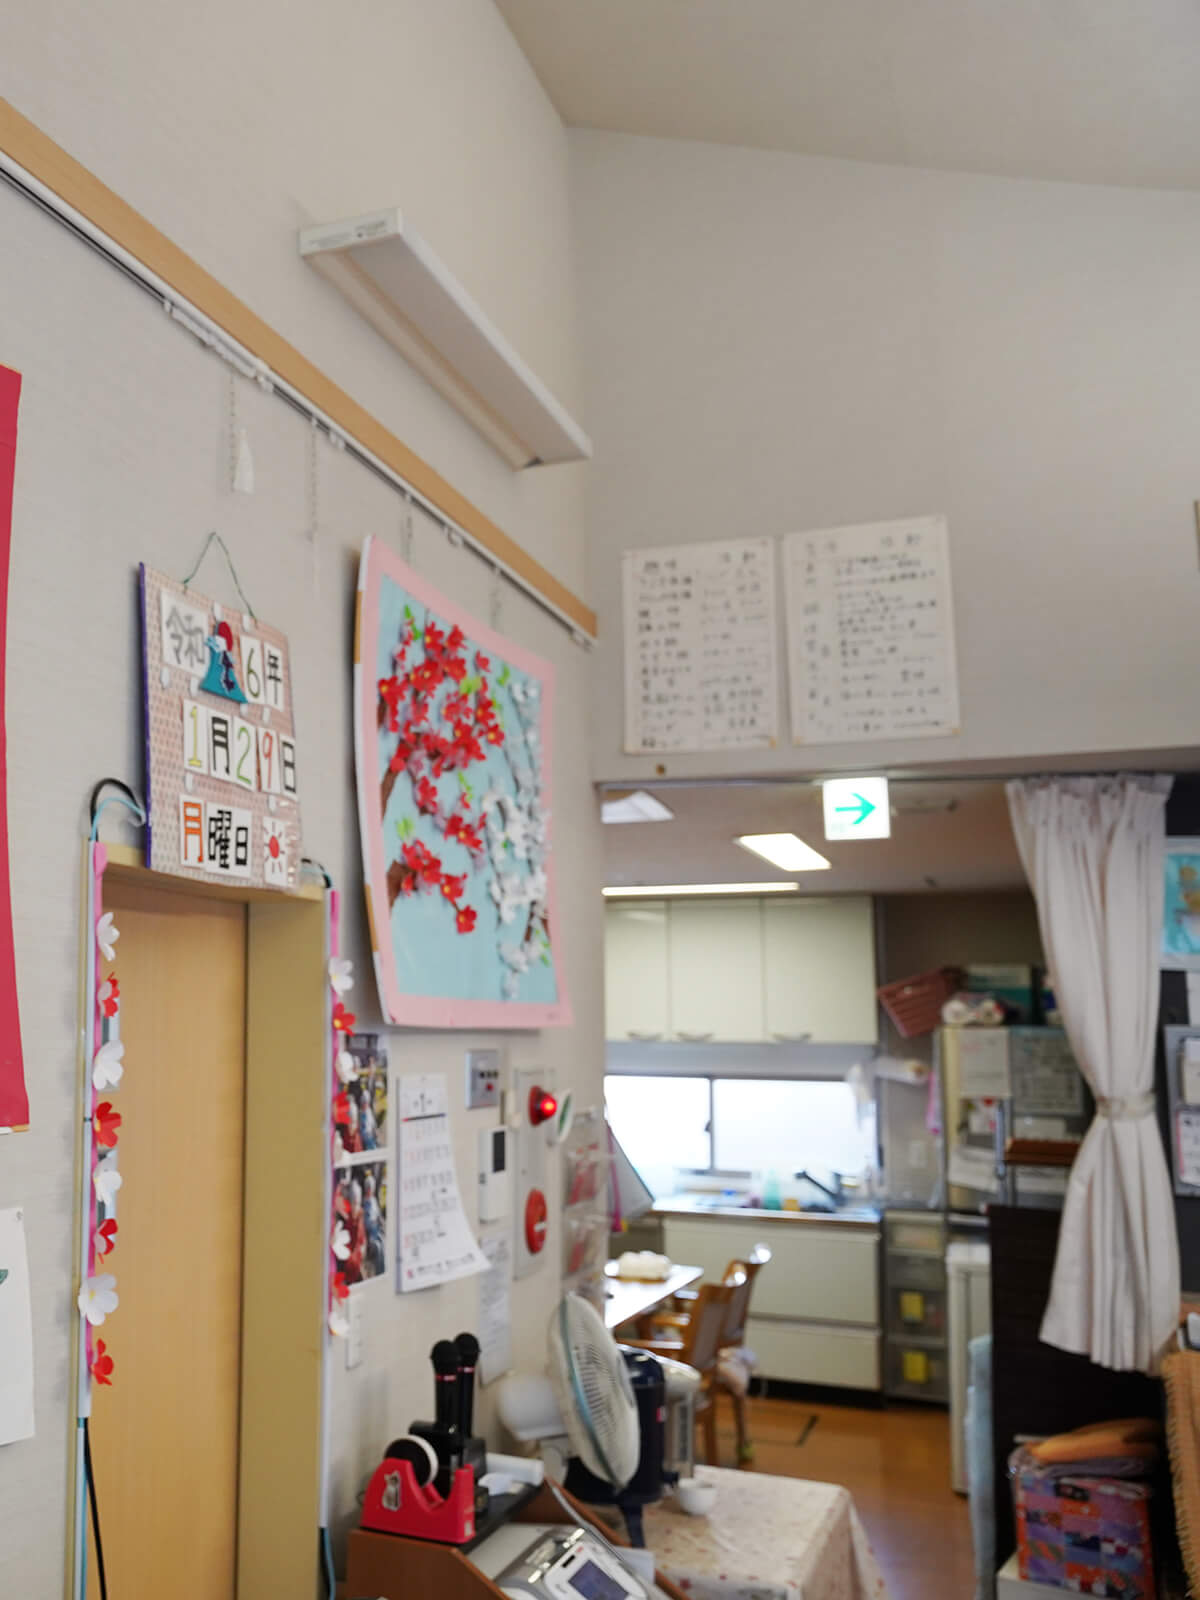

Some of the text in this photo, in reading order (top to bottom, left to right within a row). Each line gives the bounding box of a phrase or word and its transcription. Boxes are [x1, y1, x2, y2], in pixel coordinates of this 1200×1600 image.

[184, 705, 297, 794] 1月29日
[183, 801, 249, 870] 月曜日
